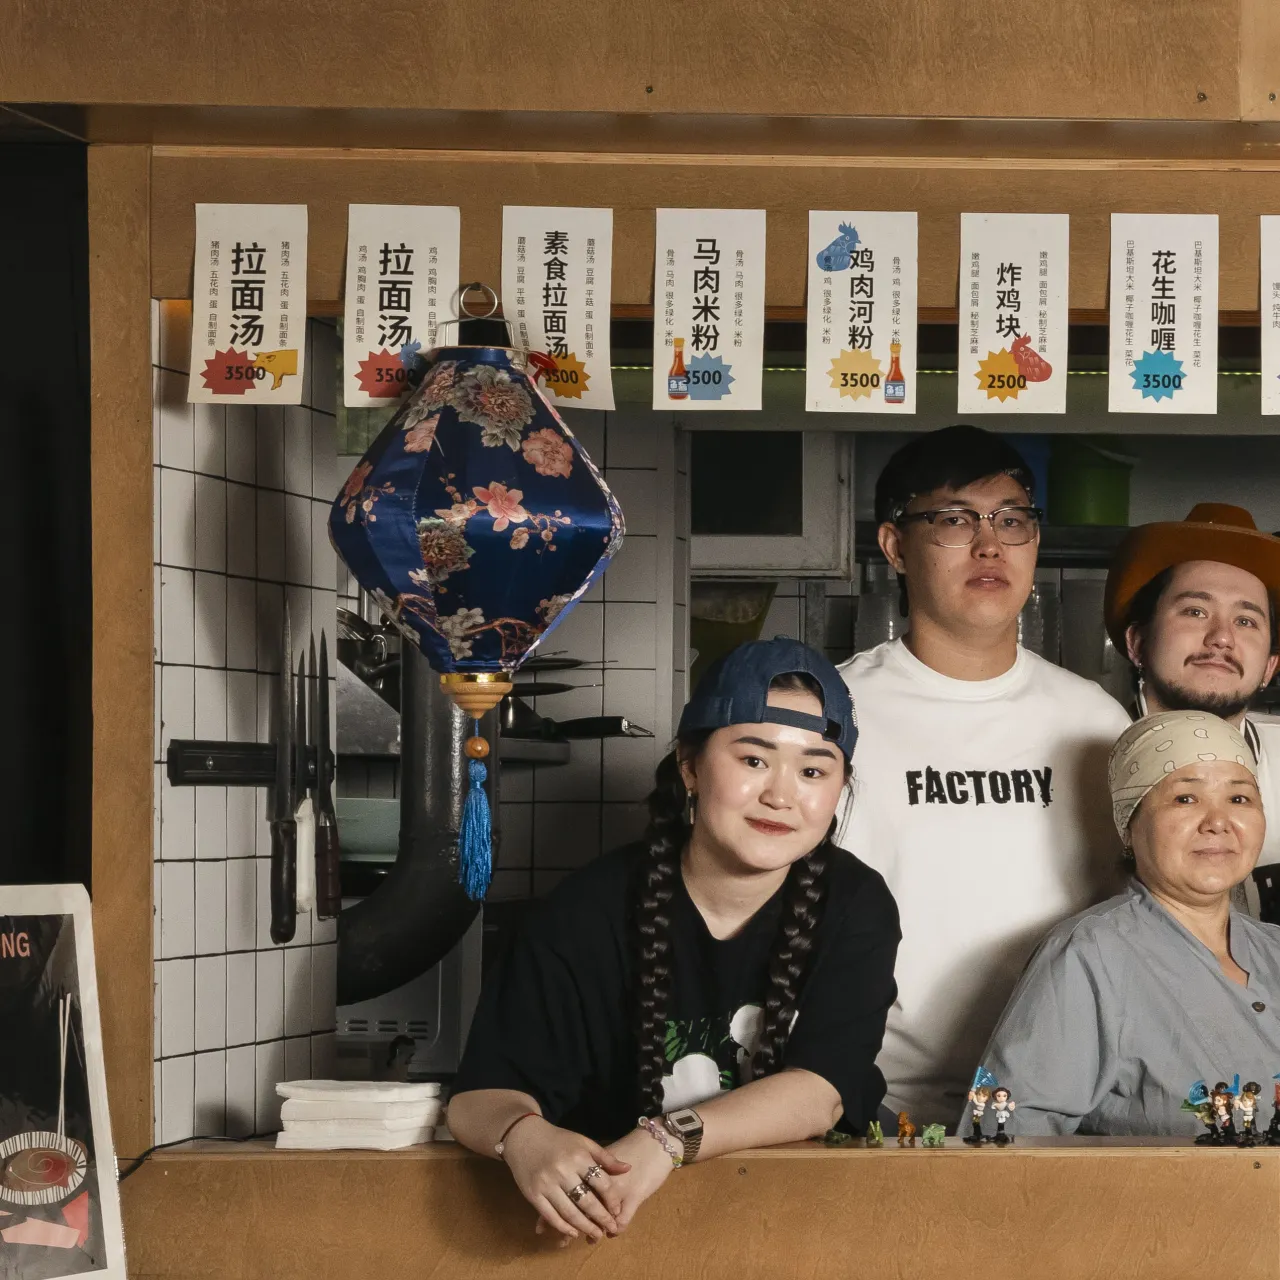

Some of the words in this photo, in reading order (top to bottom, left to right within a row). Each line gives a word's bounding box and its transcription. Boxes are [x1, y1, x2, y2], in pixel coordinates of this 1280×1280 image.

[210, 241, 220, 266] 猪肉汤
[281, 241, 290, 267] 猪肉汤
[210, 271, 219, 296] 五花肉
[281, 272, 289, 296] 五花肉
[665, 271, 674, 287] 马肉
[735, 272, 743, 288] 马肉
[230, 242, 266, 347] 拉面汤
[377, 243, 414, 347] 拉面汤
[542, 231, 569, 360] 素食拉面汤
[691, 239, 720, 351] 马肉米粉
[848, 248, 875, 350] 鸡肉河粉
[996, 263, 1022, 338] 炸鸡块
[1151, 250, 1176, 351] 花生咖喱
[208, 314, 217, 346] 自制面条
[279, 314, 288, 347] 自制面条
[356, 309, 364, 343] 自制面条
[585, 324, 594, 358] 自制面条
[225, 366, 266, 381] 3500
[545, 369, 578, 384] 3500
[684, 370, 721, 385] 3500
[840, 372, 880, 387] 3500
[987, 374, 1026, 389] 2500
[1142, 374, 1181, 389] 3500
[905, 765, 1053, 808] FACTORY
[2, 932, 30, 958] NG
